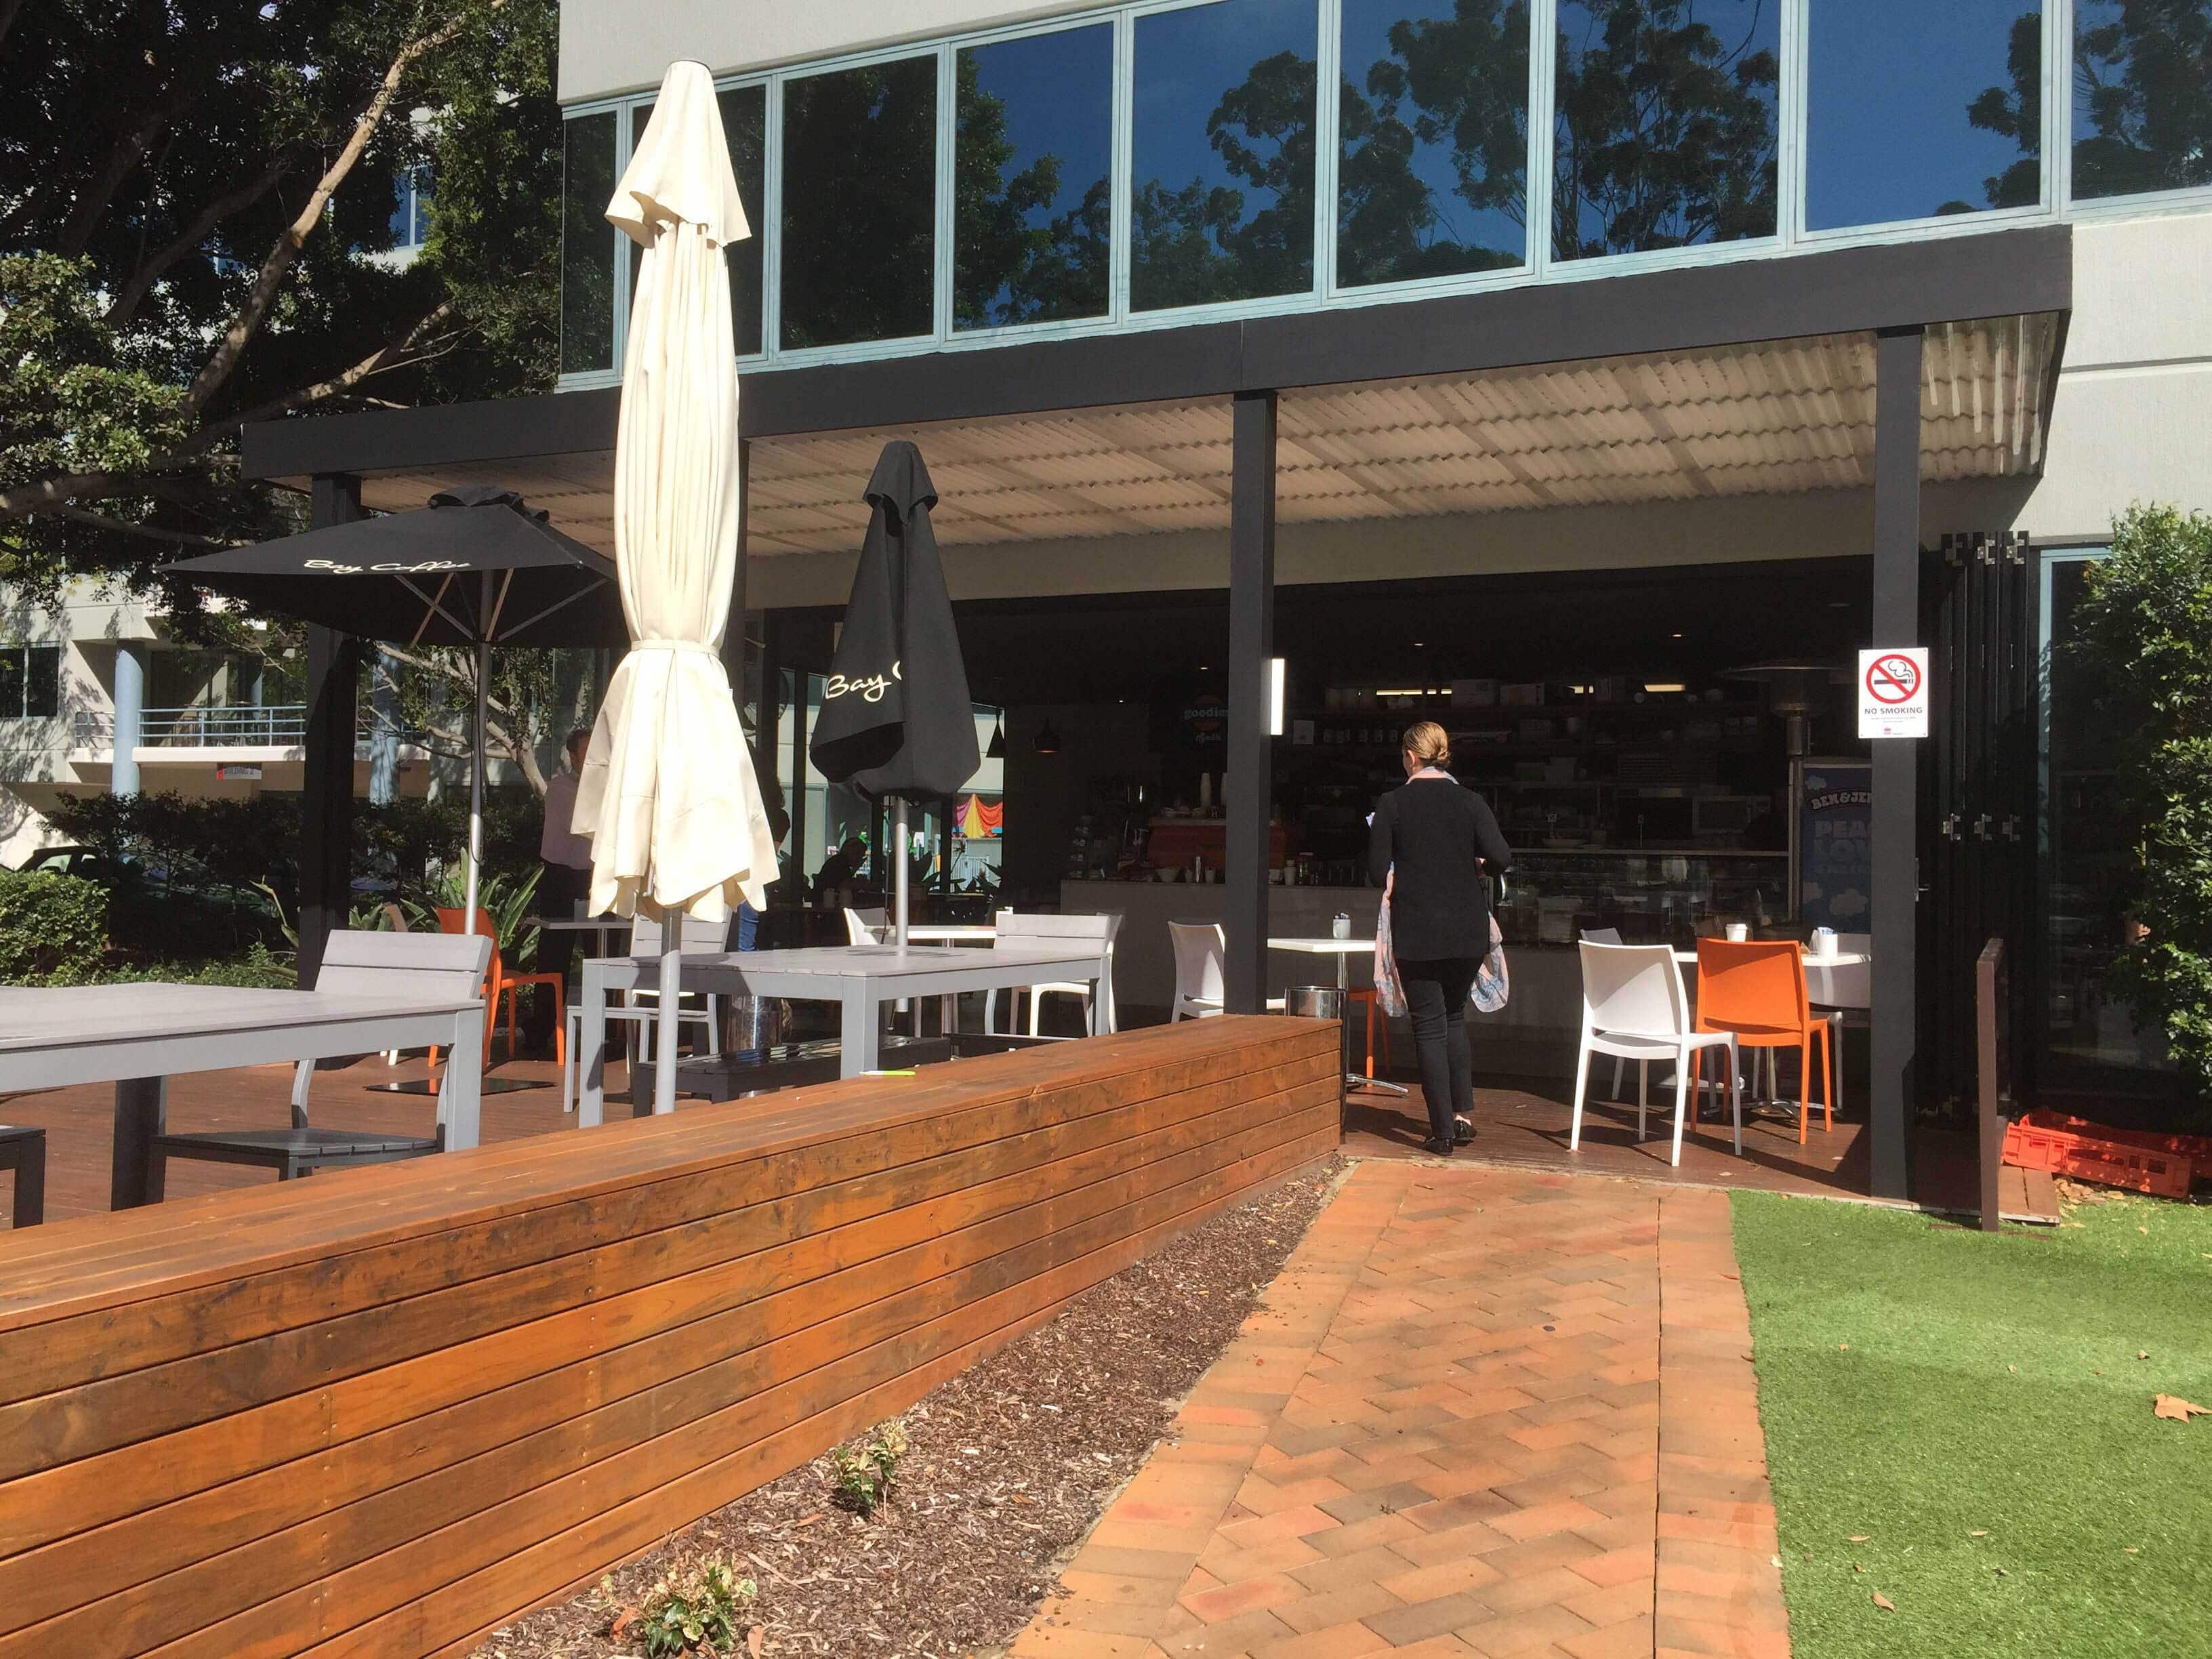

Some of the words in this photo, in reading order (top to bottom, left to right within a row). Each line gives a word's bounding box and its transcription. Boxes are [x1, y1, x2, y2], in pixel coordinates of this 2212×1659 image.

[304, 559, 363, 574] Bay
[825, 674, 892, 703] Bay
[1880, 707, 1923, 715] SMOKING
